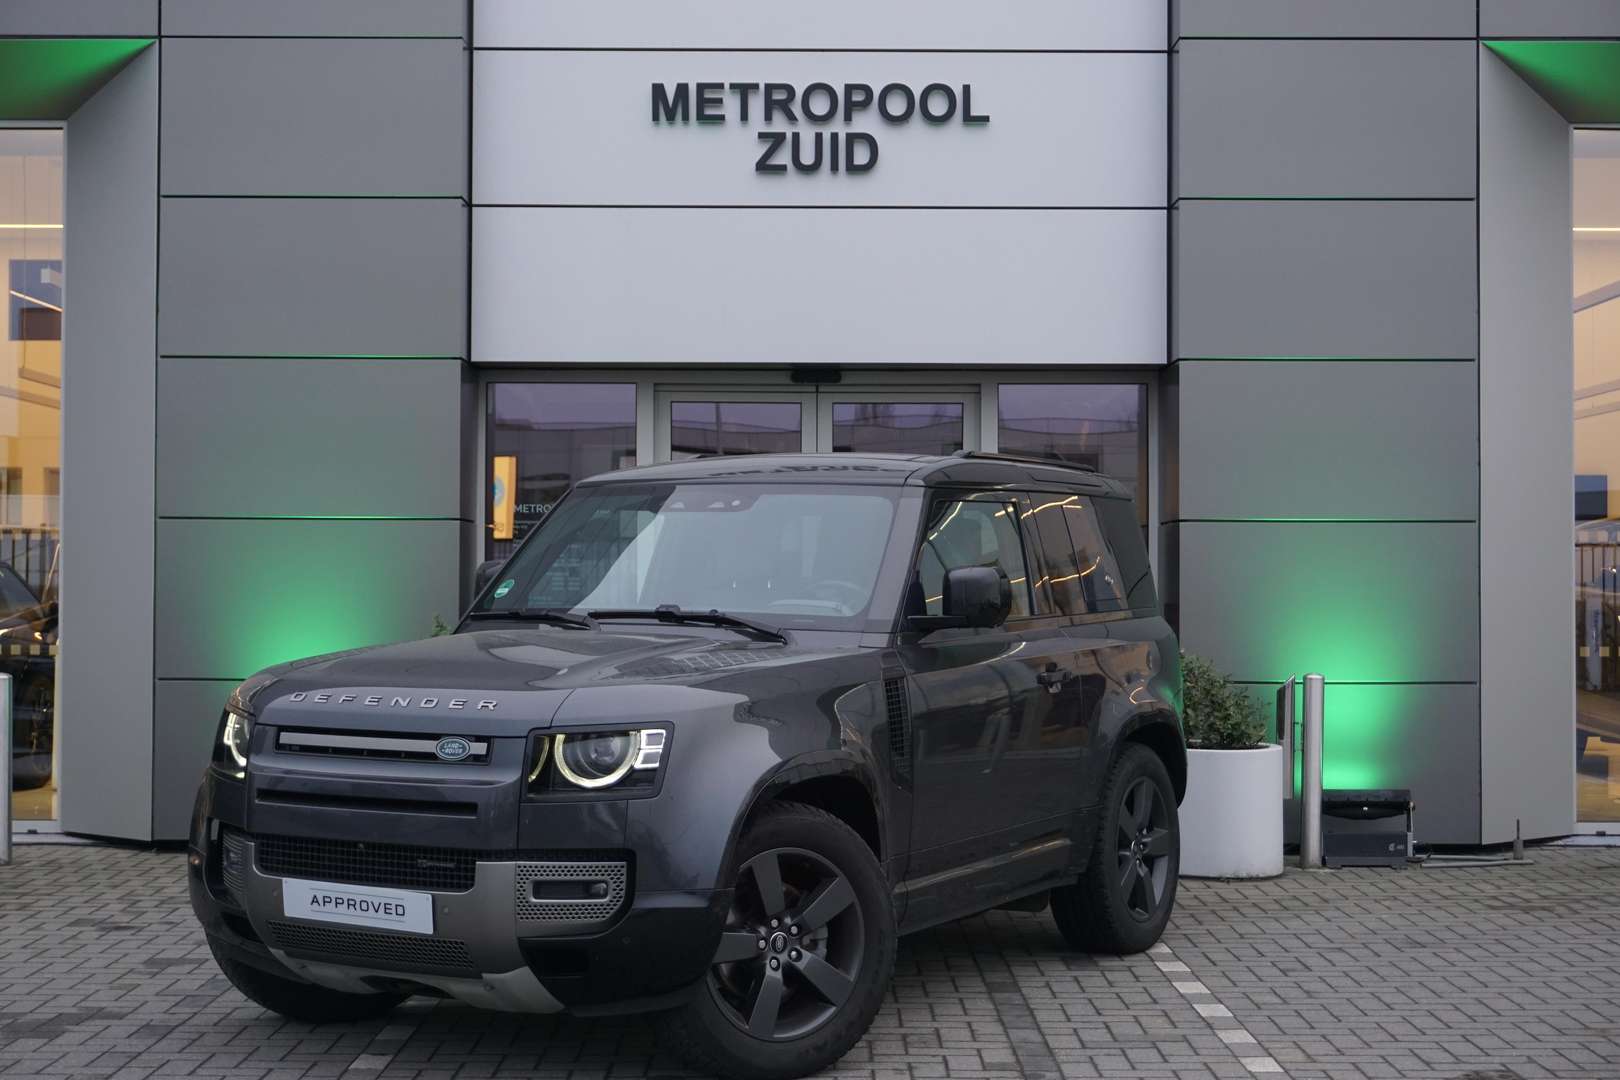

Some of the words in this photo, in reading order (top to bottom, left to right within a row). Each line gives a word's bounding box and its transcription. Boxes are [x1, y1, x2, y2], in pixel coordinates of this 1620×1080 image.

[651, 82, 990, 123] METROPOOL
[755, 131, 879, 172] ZUID
[513, 504, 553, 513] METRO
[289, 692, 499, 711] DEFENDER
[310, 894, 405, 917] APPROVED
